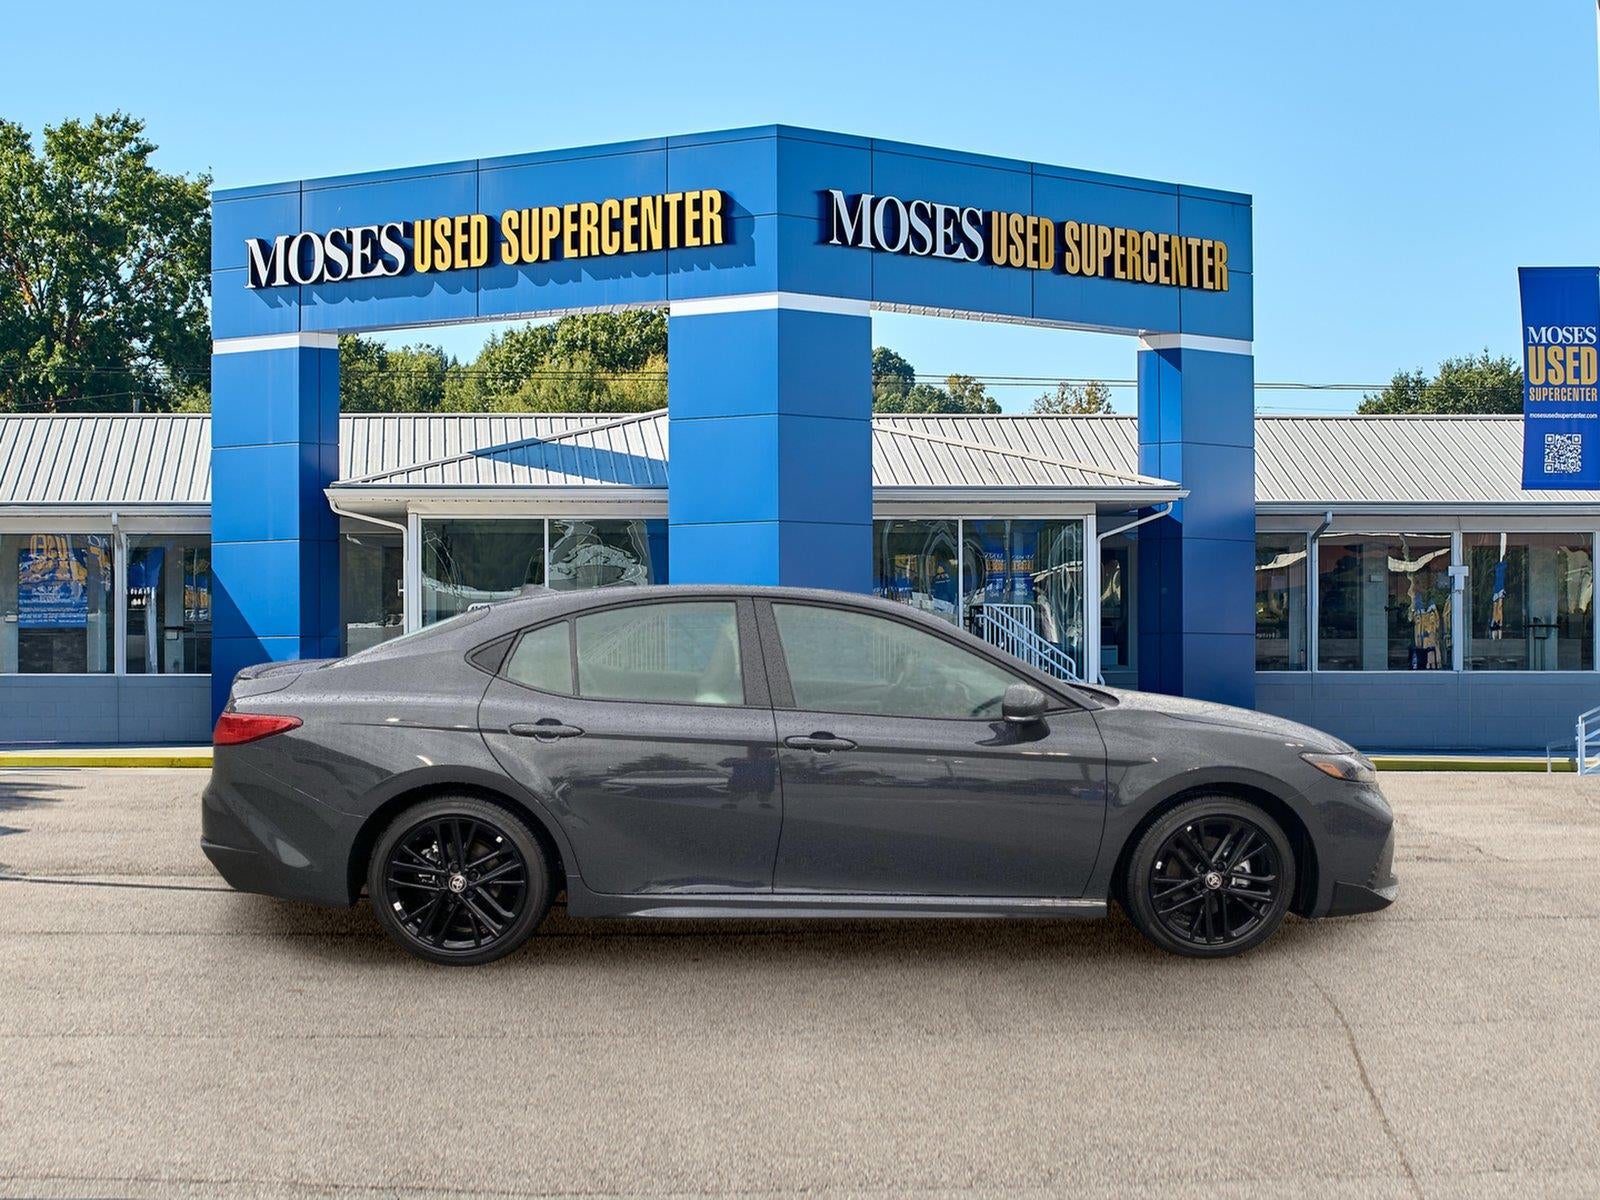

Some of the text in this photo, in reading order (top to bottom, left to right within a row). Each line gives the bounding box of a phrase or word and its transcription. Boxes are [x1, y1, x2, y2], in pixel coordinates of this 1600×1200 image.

[244, 188, 724, 289] MOSES USED SUPERCENTER
[828, 188, 1229, 292] MOSES USED SUPERCENTER
[1527, 325, 1597, 345] MOSES
[1527, 345, 1598, 386] USED
[1529, 386, 1598, 402] SUPERCENTER
[1529, 412, 1598, 420] mosesusedsupercenter.com
